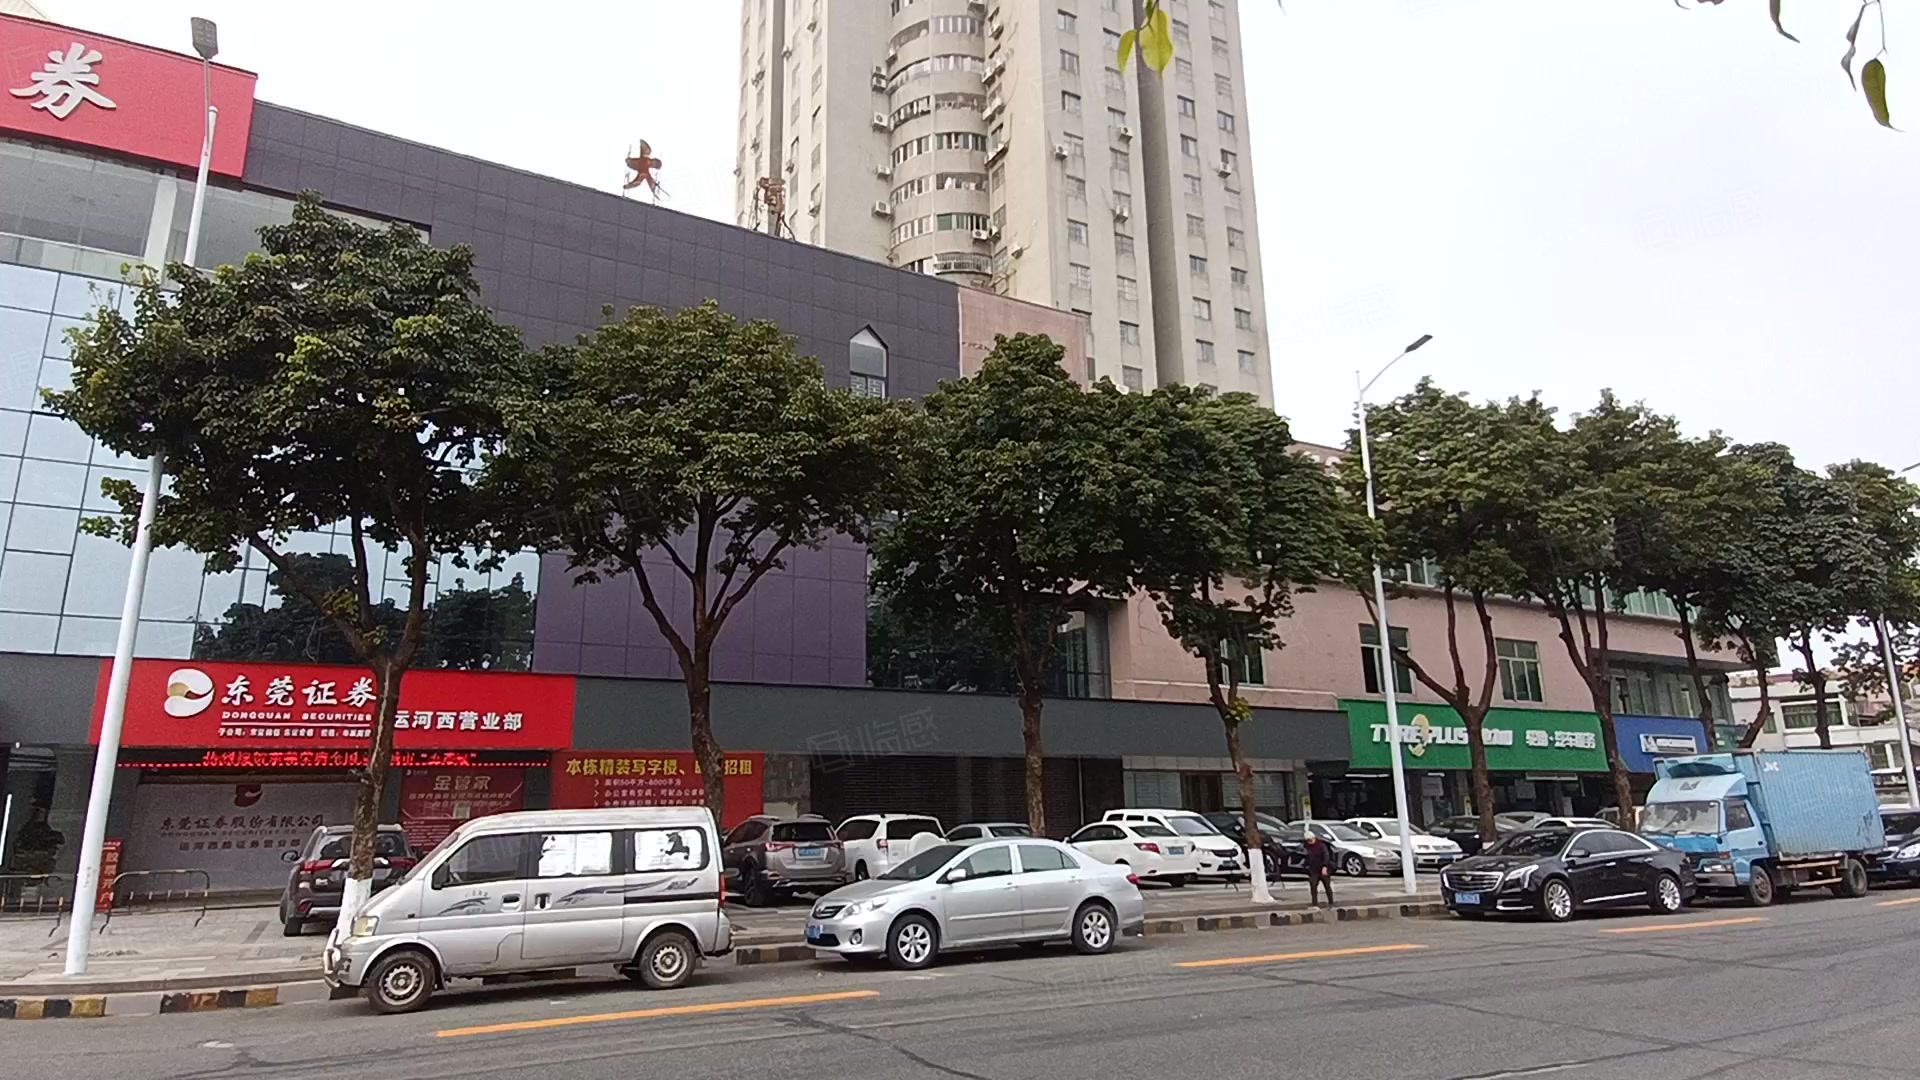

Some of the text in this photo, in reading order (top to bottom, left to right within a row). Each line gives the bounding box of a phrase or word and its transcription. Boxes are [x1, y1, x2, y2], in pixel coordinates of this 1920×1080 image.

[9, 42, 117, 119] 券
[221, 674, 377, 708] 东莞证券
[222, 711, 372, 721] DONGGUAN SECURITIES
[432, 775, 492, 791] 金管家
[160, 814, 324, 831] 东莞证券股份有限公司
